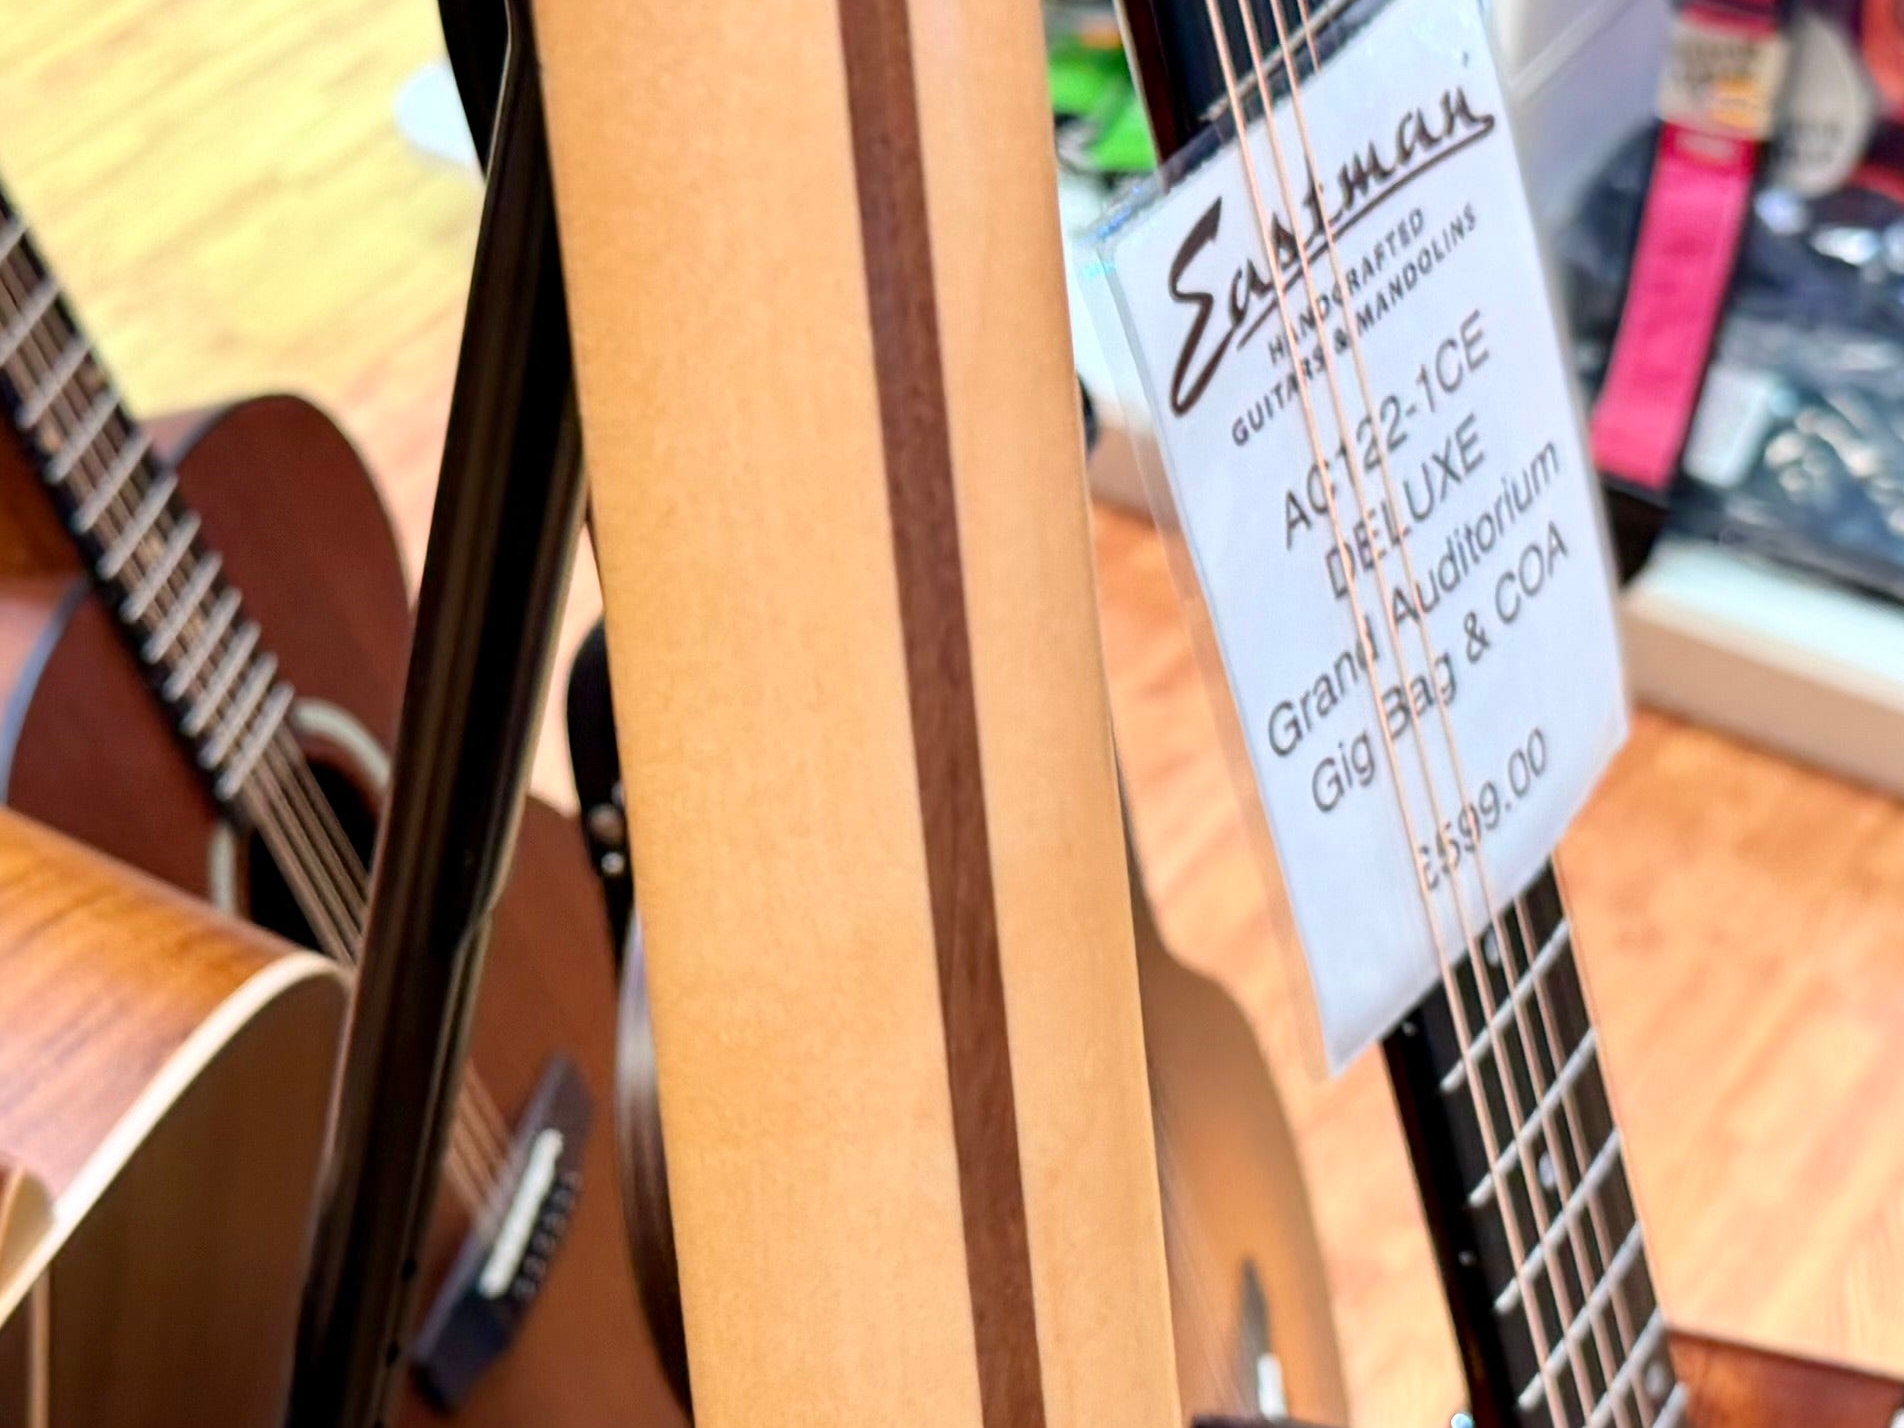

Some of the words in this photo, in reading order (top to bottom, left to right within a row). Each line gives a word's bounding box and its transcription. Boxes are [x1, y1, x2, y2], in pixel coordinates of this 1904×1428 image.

[1168, 86, 1495, 418] Eastman
[1231, 349, 1327, 446] GUITARS
[1355, 201, 1478, 335] MANDOLINS
[1268, 207, 1425, 365] HANDCRAFTED
[1285, 309, 1490, 551] AC122-1CE
[1325, 413, 1486, 600] DELUXE
[1267, 614, 1380, 758] Grand
[1391, 441, 1559, 636] Auditorium
[1311, 729, 1377, 814] Gig
[1380, 650, 1458, 740] Bag
[1462, 610, 1491, 664] &
[1495, 519, 1569, 624] COA
